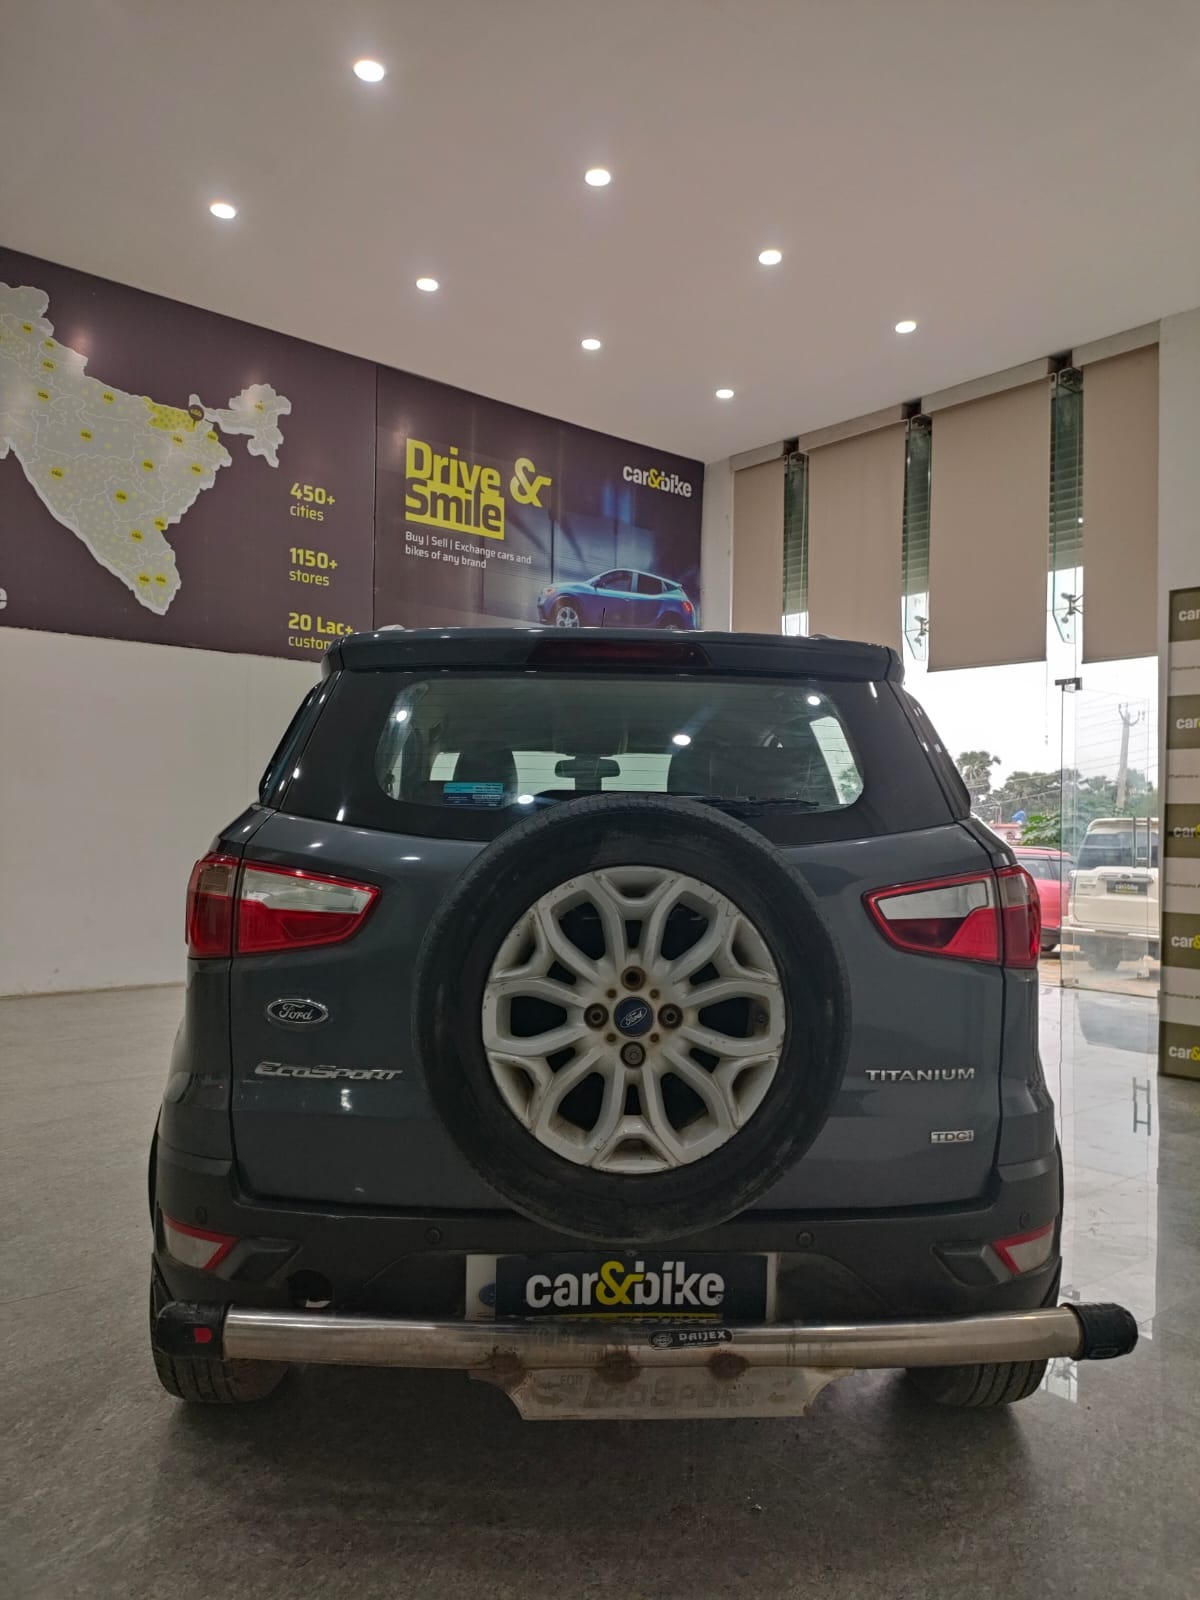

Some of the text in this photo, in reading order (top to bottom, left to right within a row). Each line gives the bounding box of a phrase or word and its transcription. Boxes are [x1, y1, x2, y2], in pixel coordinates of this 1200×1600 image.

[405, 438, 552, 507] Drive &
[623, 465, 692, 498] car&bike
[290, 482, 336, 505] 450+
[405, 477, 503, 533] Smile
[289, 504, 325, 521] cities
[289, 547, 338, 570] 1150+
[405, 531, 424, 545] Buy
[431, 536, 448, 548] Sell
[454, 541, 496, 559] Exchange
[497, 551, 515, 561] cars
[515, 555, 532, 565] and
[405, 544, 487, 569] bikes of any brand
[289, 569, 330, 587] stores
[288, 612, 354, 636] 20 Lac+
[1176, 717, 1200, 730] car
[865, 1068, 975, 1081] TITANIUM
[526, 1260, 725, 1309] car&bike
